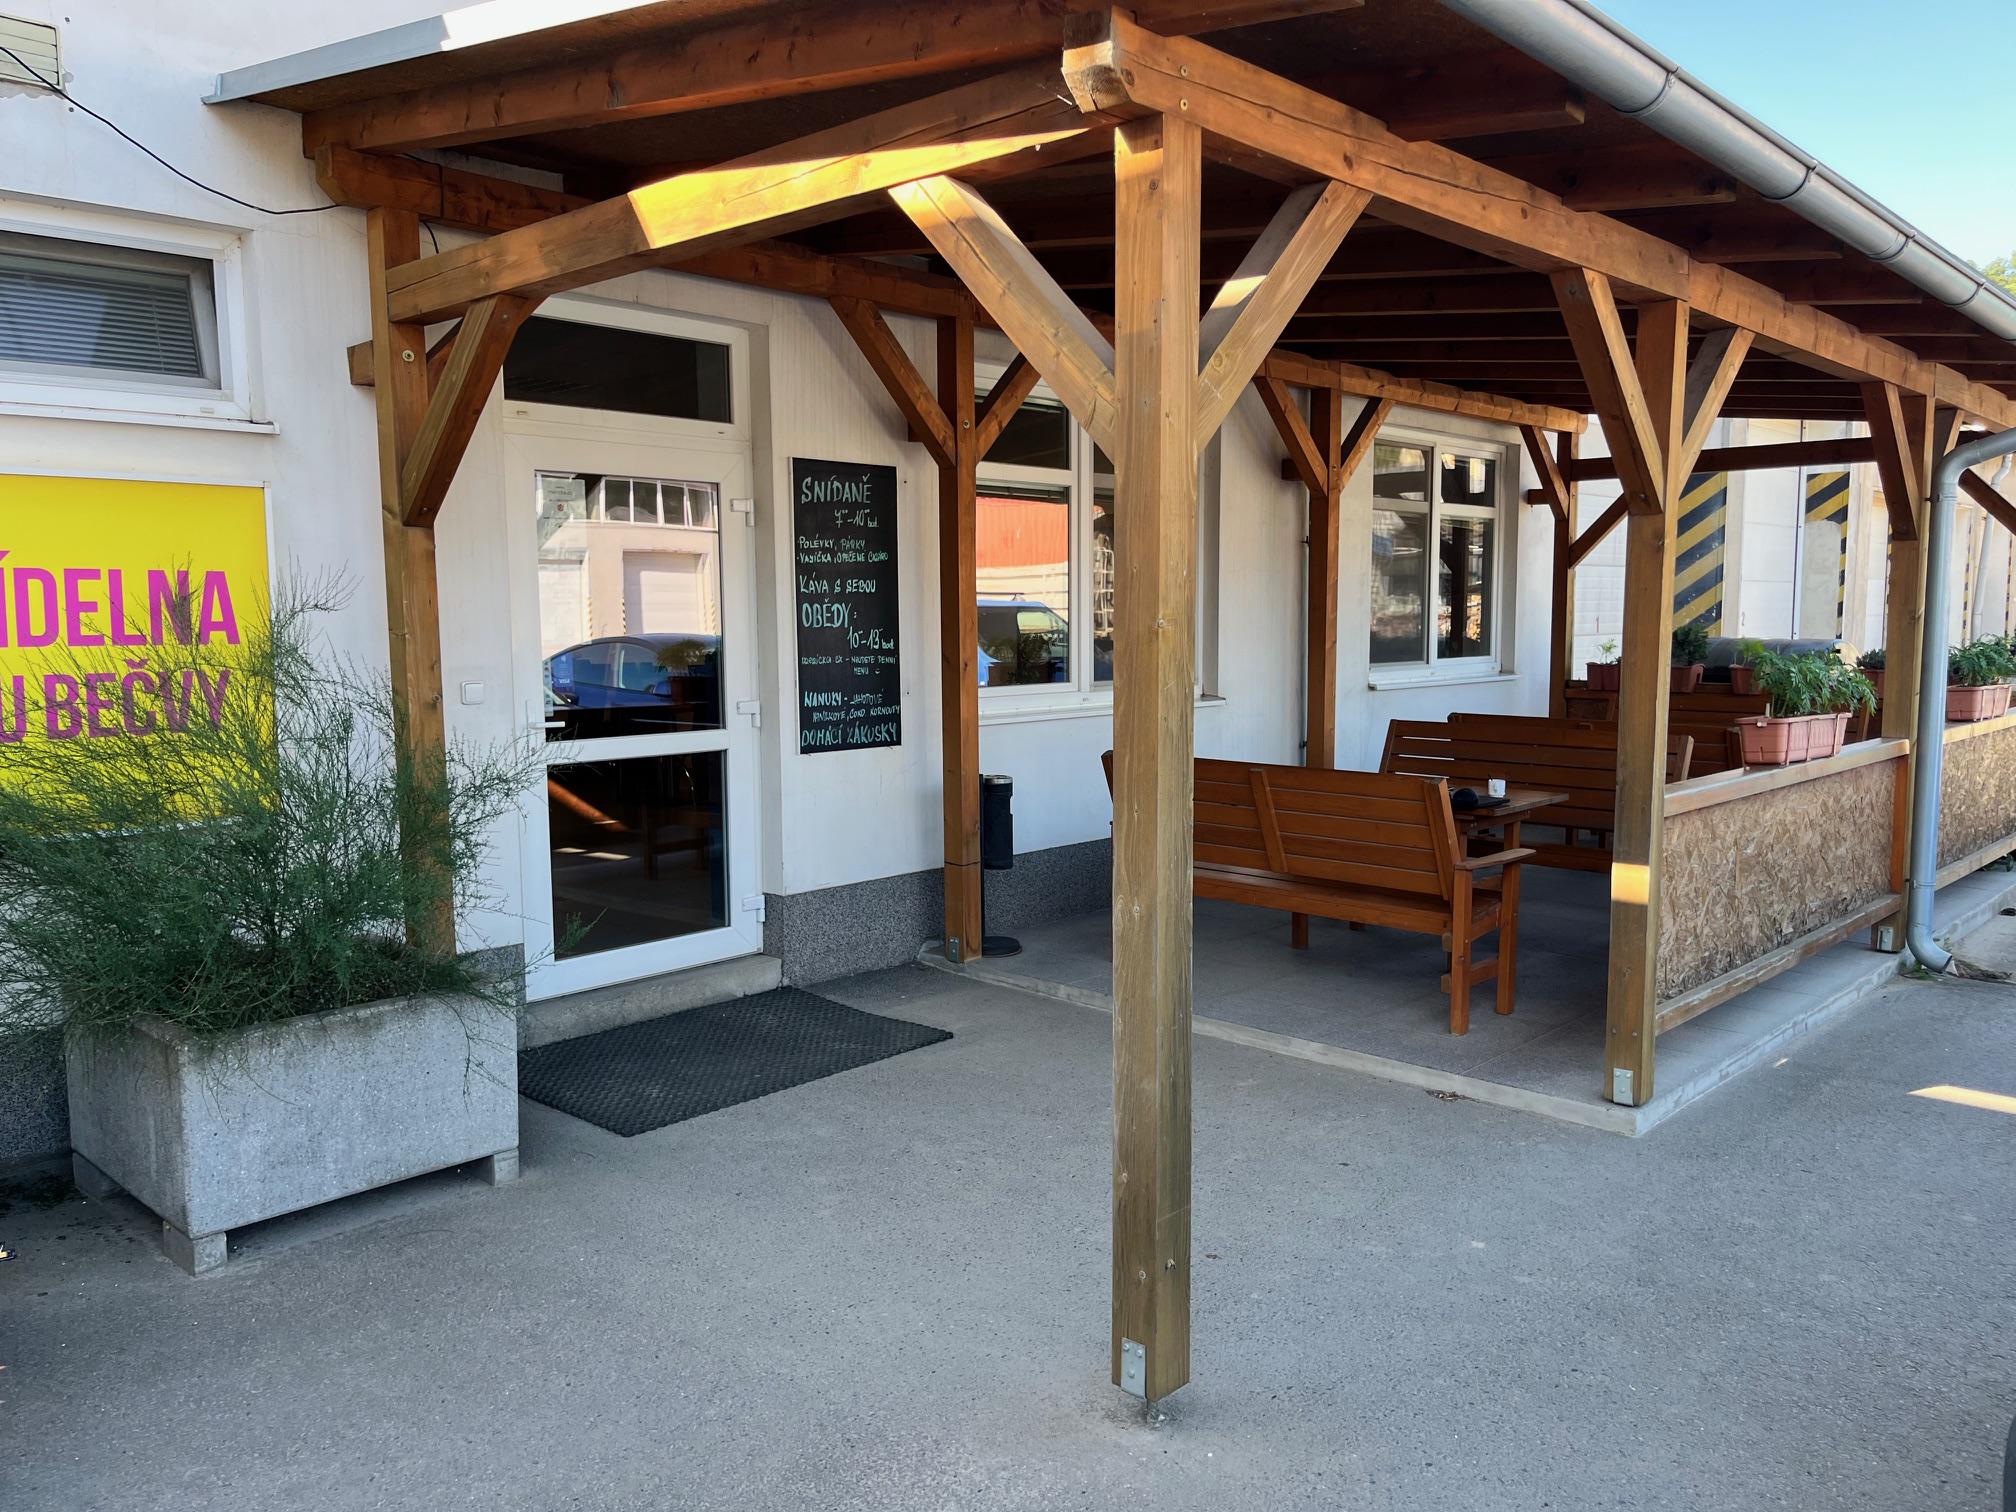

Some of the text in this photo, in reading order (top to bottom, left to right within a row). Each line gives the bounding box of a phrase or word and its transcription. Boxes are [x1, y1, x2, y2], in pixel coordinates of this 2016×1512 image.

[801, 473, 873, 504] SNÍDANĚ
[799, 571, 876, 594] KÁVA S SEBOU
[853, 666, 869, 675] MENU
[0, 658, 232, 743] U BEČVY
[804, 691, 842, 707] NANUKY
[870, 704, 900, 717] KORNOUTY
[801, 721, 897, 747] DOMÁCÍ ZÁKUSKY
